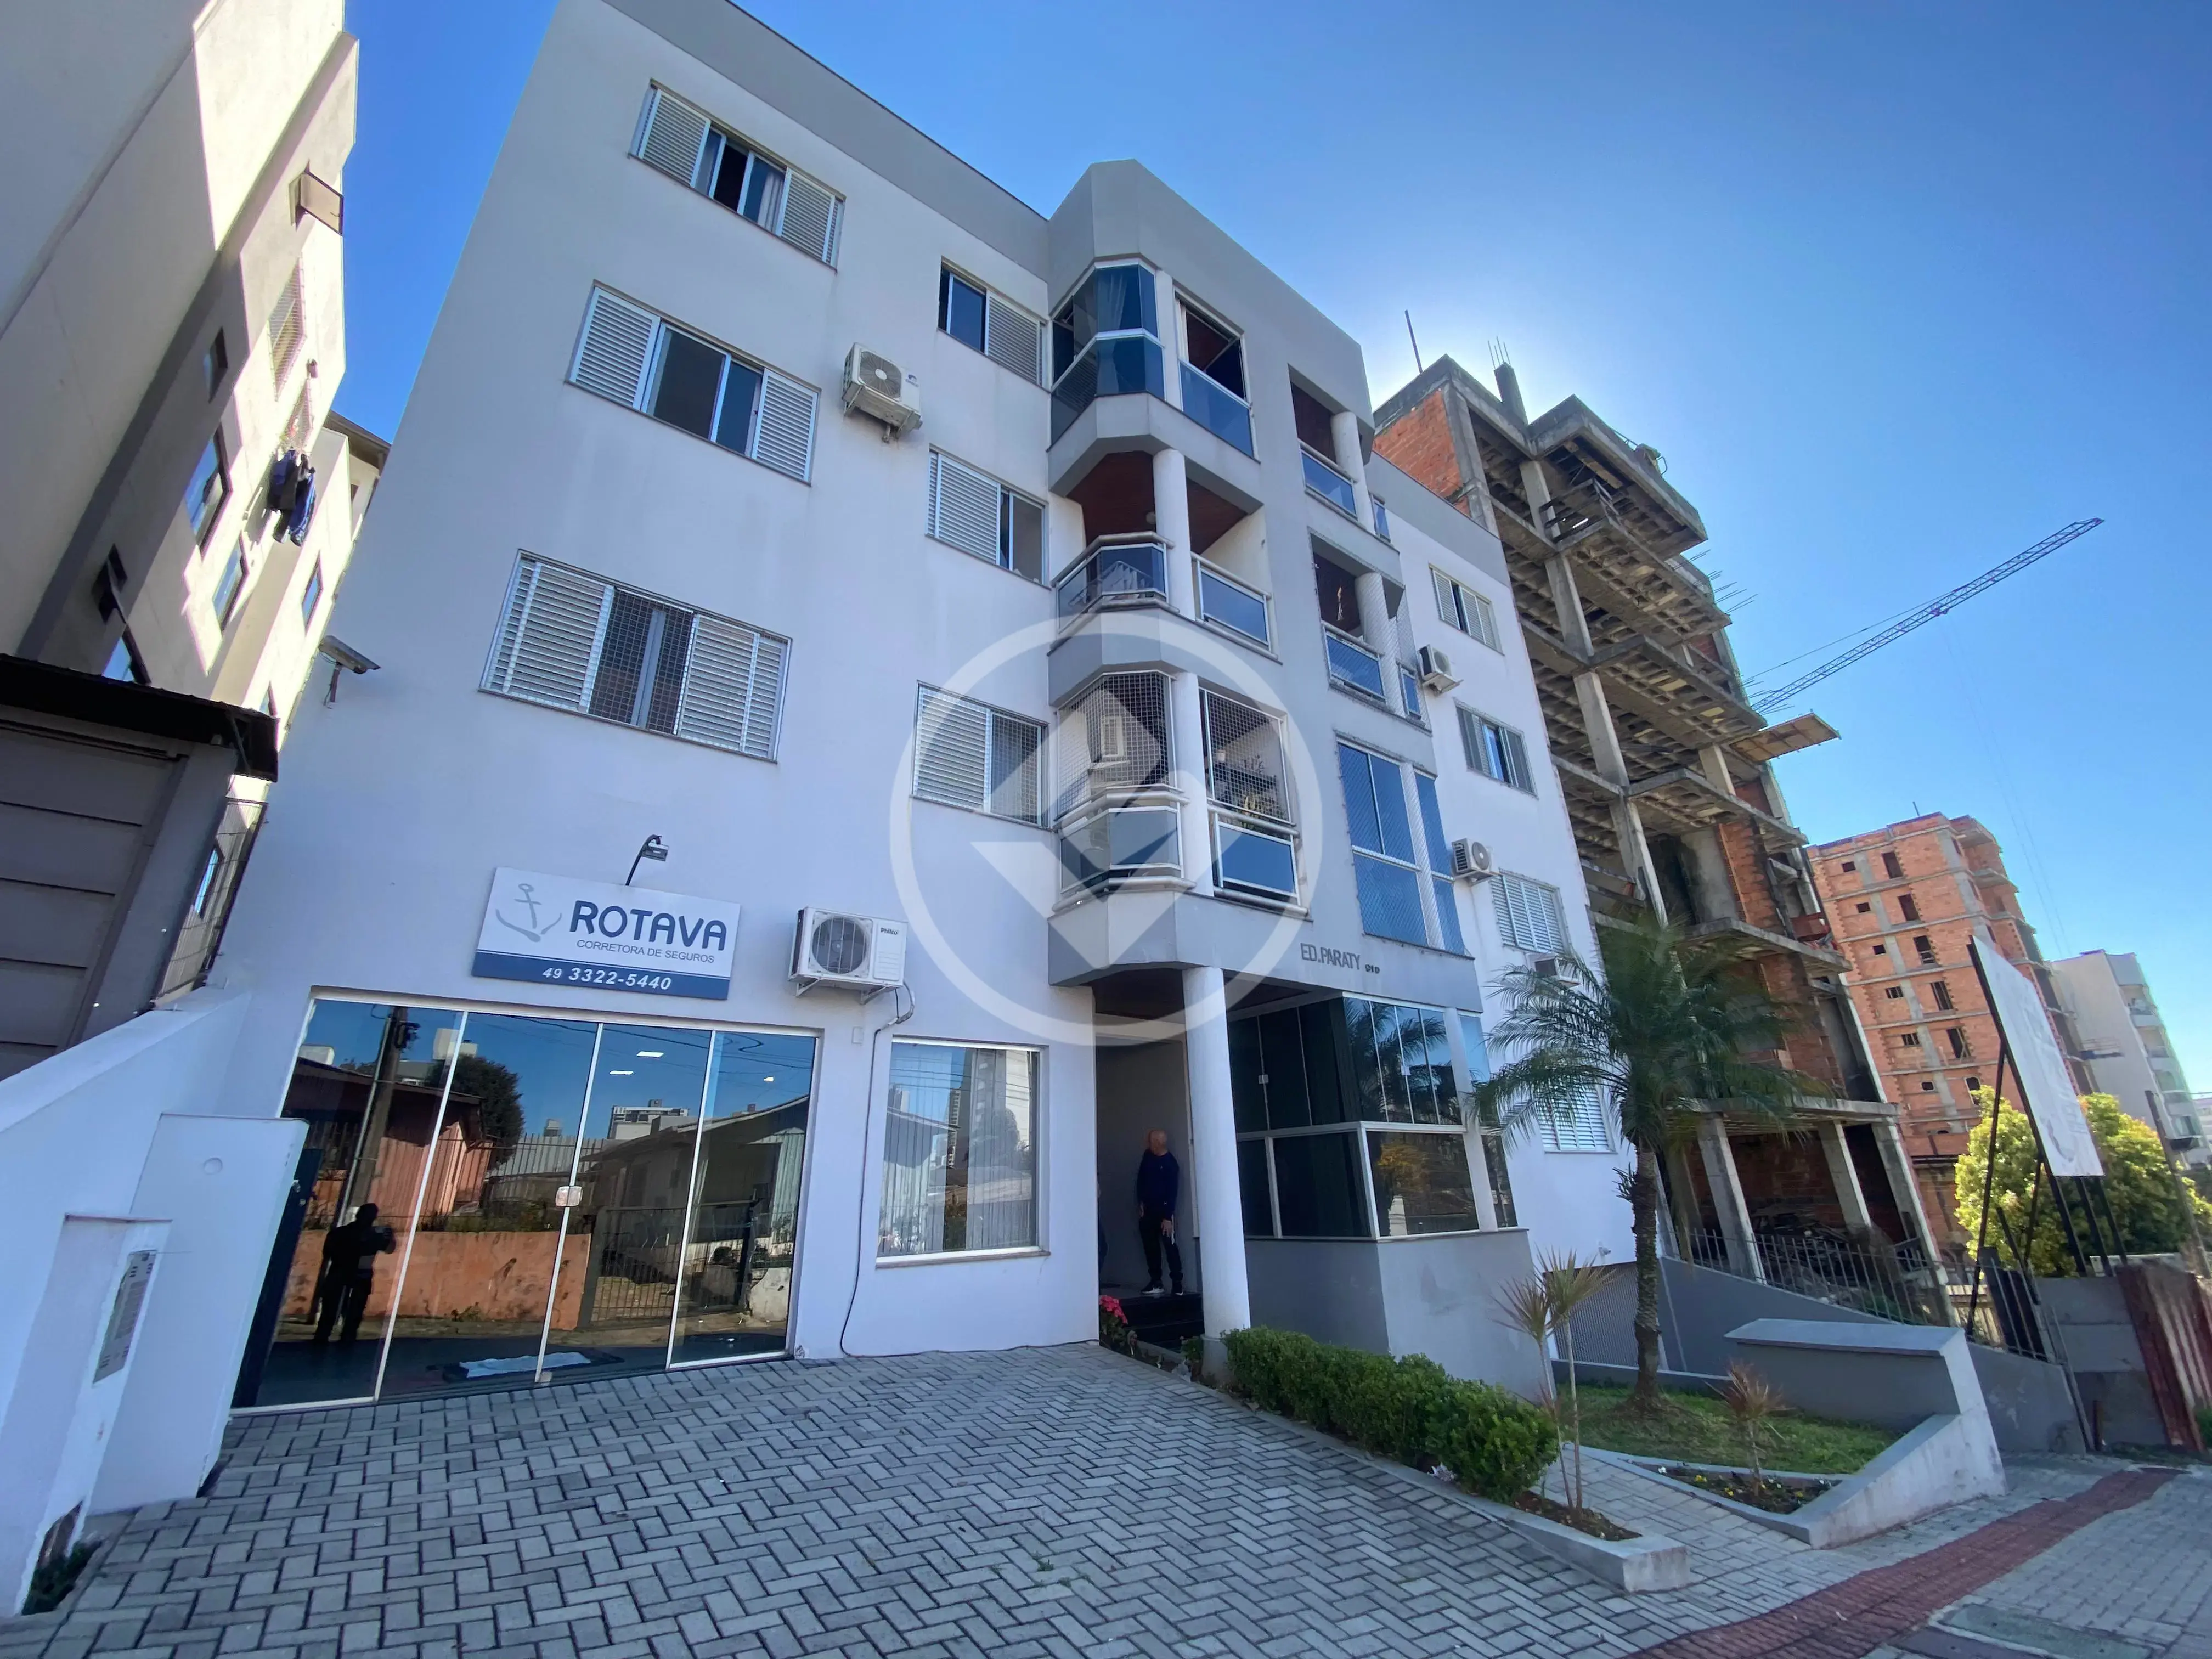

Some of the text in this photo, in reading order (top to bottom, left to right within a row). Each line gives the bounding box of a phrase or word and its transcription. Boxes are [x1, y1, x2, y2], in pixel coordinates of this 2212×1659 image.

[569, 900, 727, 951] ROTAVA
[577, 939, 715, 963] CORRETORA DE SEGUROS
[542, 967, 672, 990] 49 3322-5440
